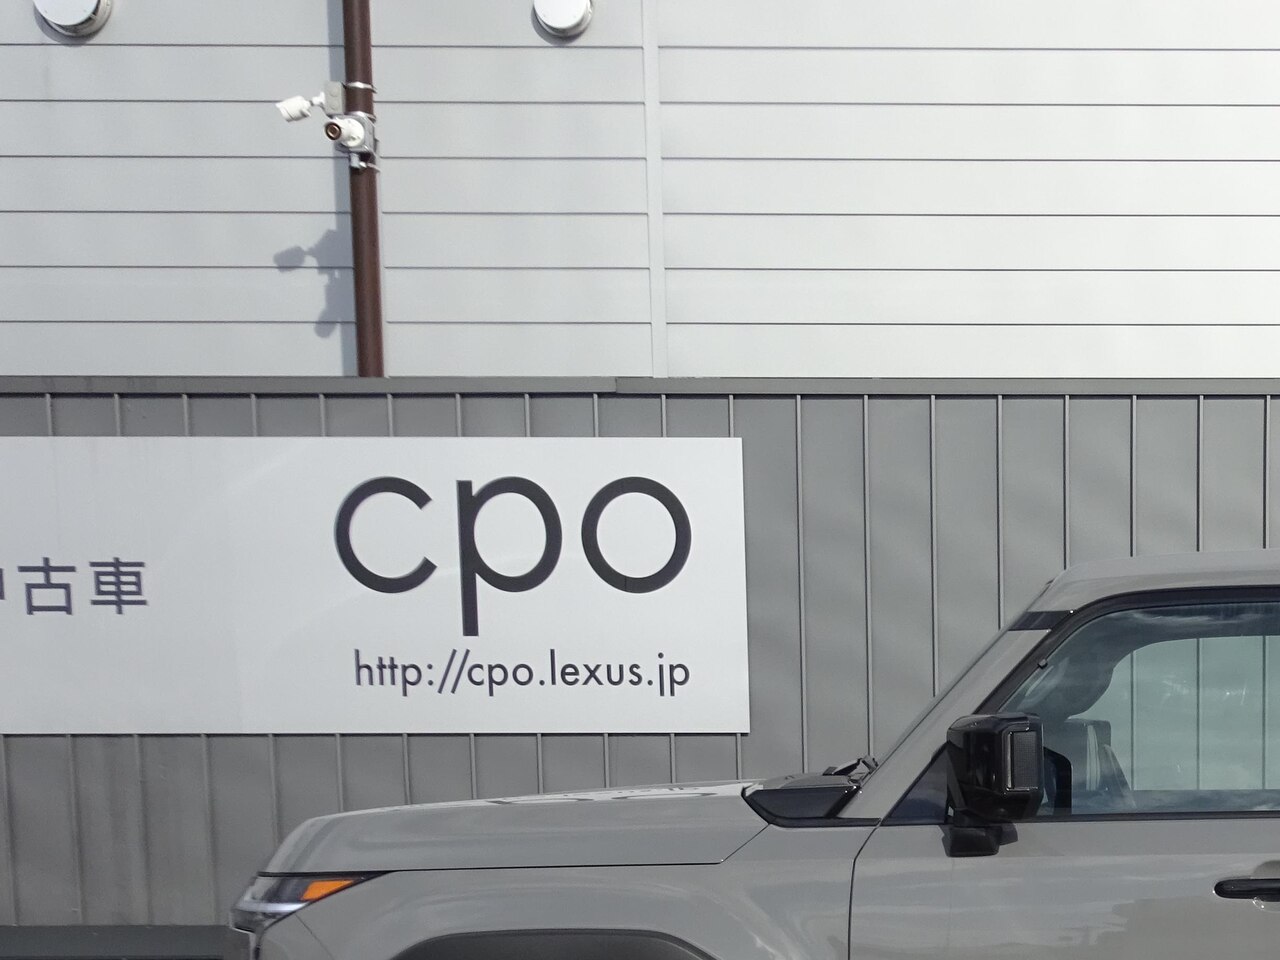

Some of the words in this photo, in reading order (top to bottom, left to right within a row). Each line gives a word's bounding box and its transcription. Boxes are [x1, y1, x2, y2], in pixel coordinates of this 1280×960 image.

[0, 556, 149, 616] 古車
[334, 476, 692, 636] cpo
[354, 649, 691, 696] http://cpo.lexus.jp
